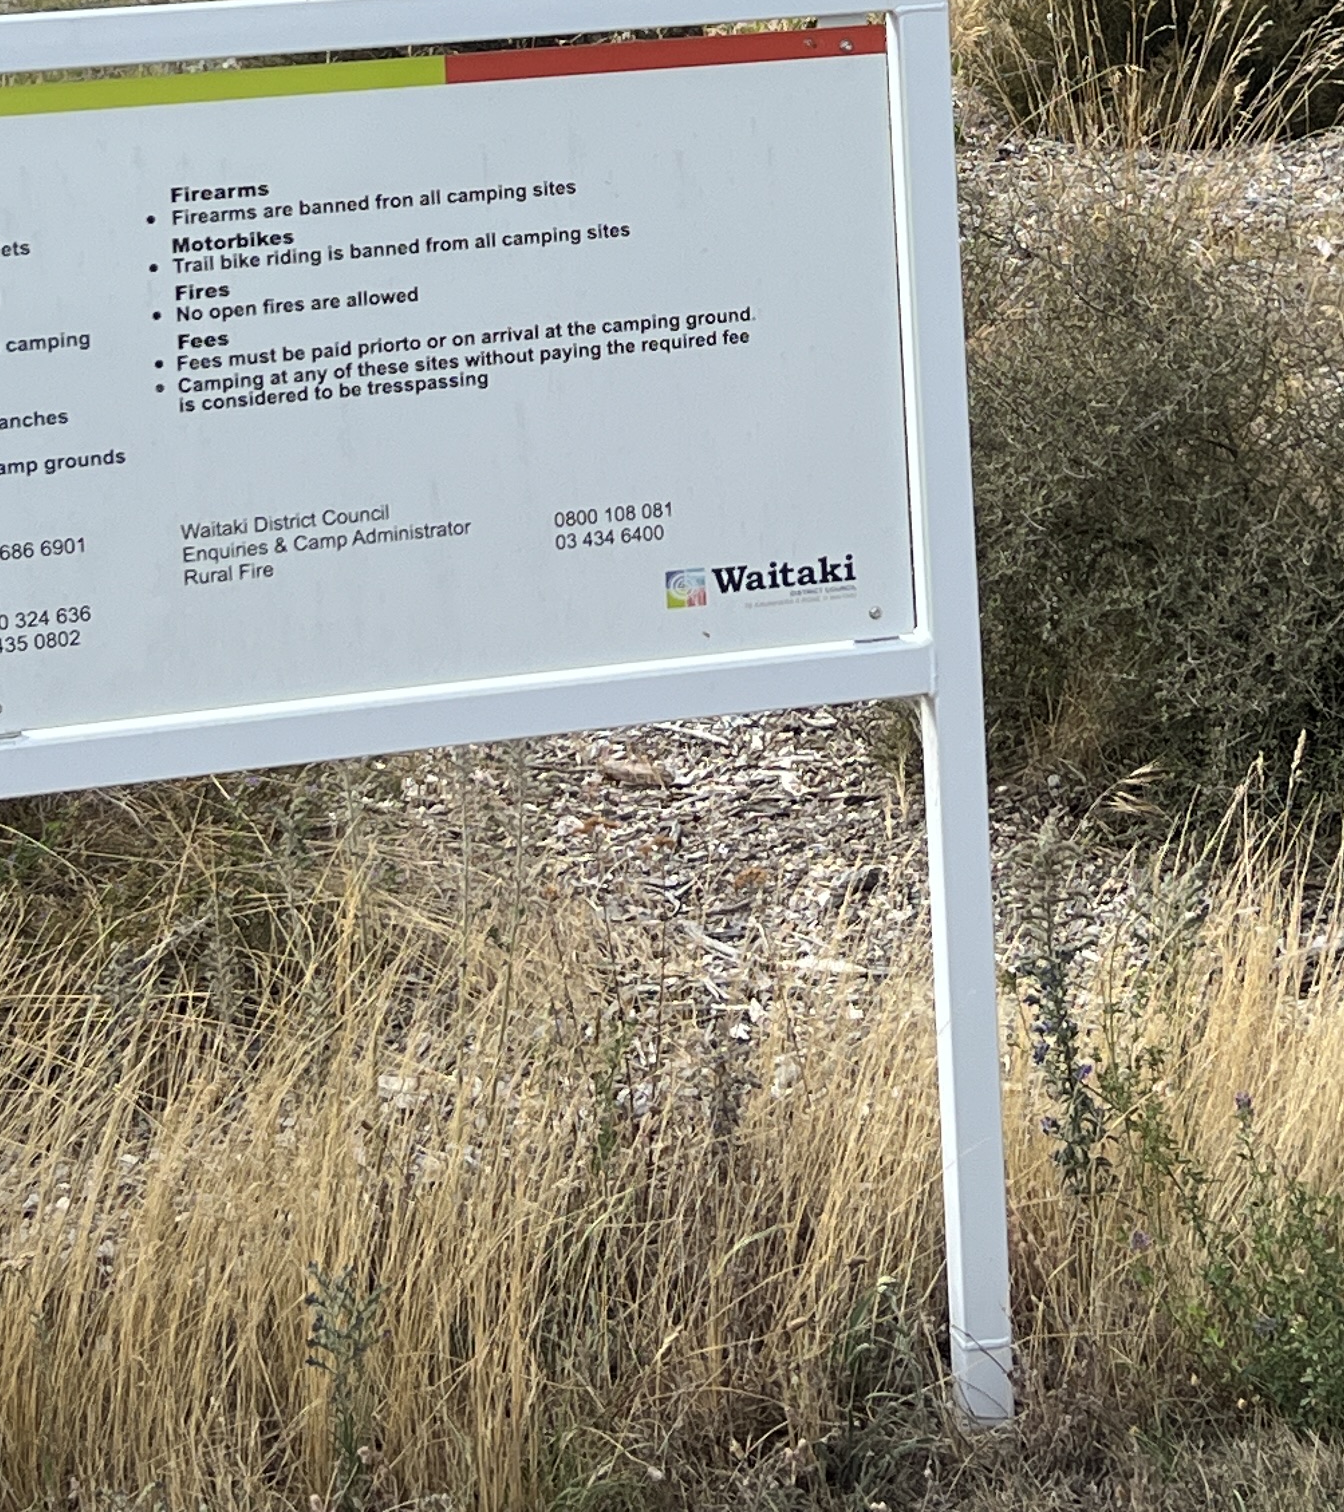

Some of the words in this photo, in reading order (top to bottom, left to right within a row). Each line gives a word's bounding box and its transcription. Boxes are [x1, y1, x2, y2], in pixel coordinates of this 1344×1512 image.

[170, 184, 270, 204] Firearms
[171, 207, 258, 226] Firearms
[263, 204, 294, 219] are
[298, 194, 370, 216] banned
[374, 193, 414, 210] fron
[419, 188, 441, 207] all
[446, 184, 527, 205] camping
[532, 180, 577, 198] sites
[171, 231, 295, 254] Motorbikes
[171, 255, 215, 274] Trail
[220, 252, 261, 270] bike
[266, 248, 322, 267] riding
[327, 244, 345, 262] is
[349, 238, 420, 260] banned
[425, 236, 469, 253] from
[474, 231, 496, 249] all
[501, 226, 582, 248] camping
[586, 223, 631, 240] sites
[174, 283, 231, 302] Fires
[176, 305, 204, 323] No
[208, 303, 258, 323] open
[262, 298, 306, 315] fires
[310, 296, 341, 311] are
[346, 286, 419, 308] allowed
[177, 333, 230, 351] Fees
[179, 396, 196, 413] is
[201, 385, 309, 411] considered
[313, 383, 333, 401] to
[339, 382, 362, 399] be
[367, 371, 489, 396] tresspassing
[180, 518, 248, 540] Waitaki
[253, 512, 317, 533] District
[321, 503, 390, 526] Council
[553, 508, 598, 528] 0800
[604, 504, 637, 523] 108
[641, 501, 672, 520] 081
[40, 537, 85, 557] 6901
[182, 542, 269, 564] Enquiries
[273, 536, 288, 554] &
[293, 534, 348, 552] Camp
[351, 521, 472, 547] Administrator
[555, 532, 578, 551] 03
[582, 528, 615, 547] 434
[620, 524, 665, 544] 6400
[183, 564, 233, 586] Rural
[238, 563, 274, 581] Fire
[710, 553, 857, 594] Waitaki
[15, 609, 50, 629] 324
[56, 604, 92, 625] 636
[33, 629, 81, 650] 0802
